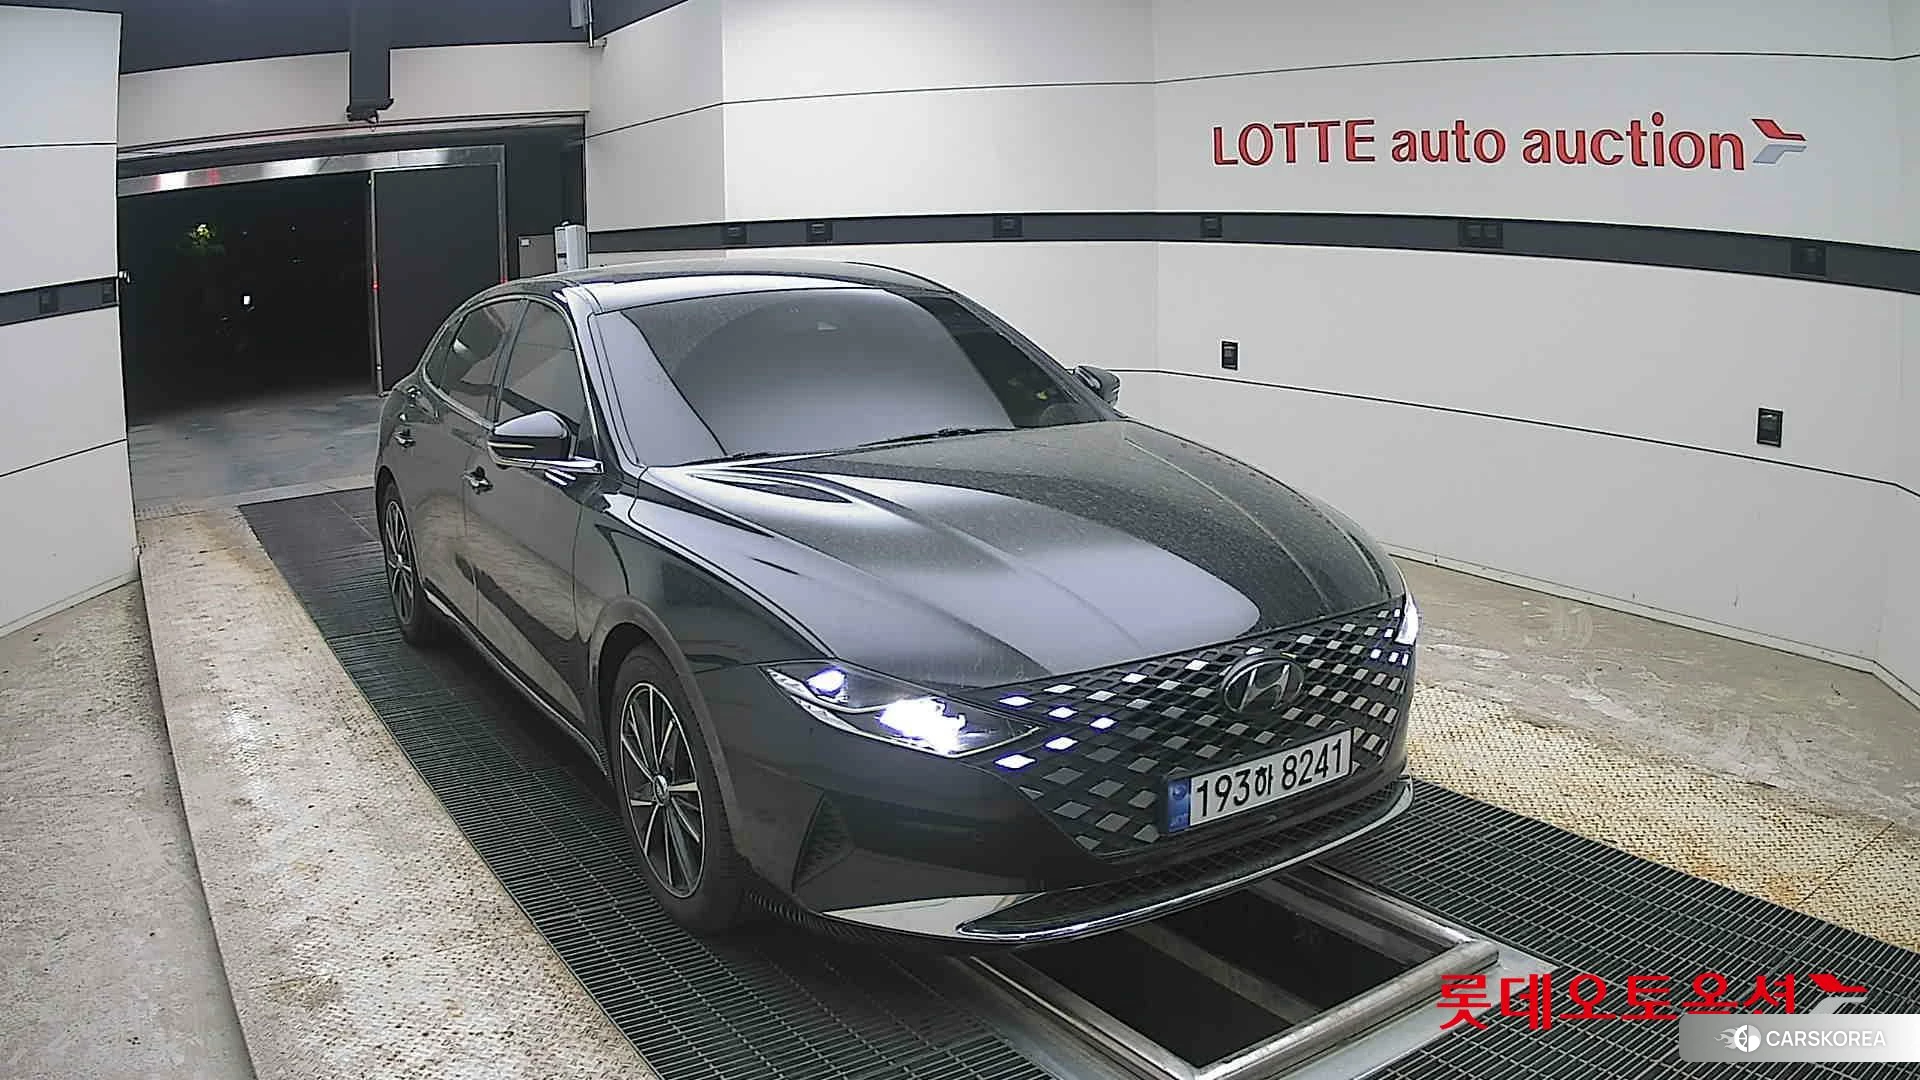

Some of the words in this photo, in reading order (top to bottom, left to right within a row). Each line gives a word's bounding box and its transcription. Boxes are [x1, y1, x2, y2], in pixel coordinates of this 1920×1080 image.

[1212, 119, 1376, 166] LOTTE
[1391, 119, 1507, 162] auto
[1522, 111, 1745, 170] auction
[1196, 763, 1274, 818] 193하
[1281, 738, 1343, 791] 8241
